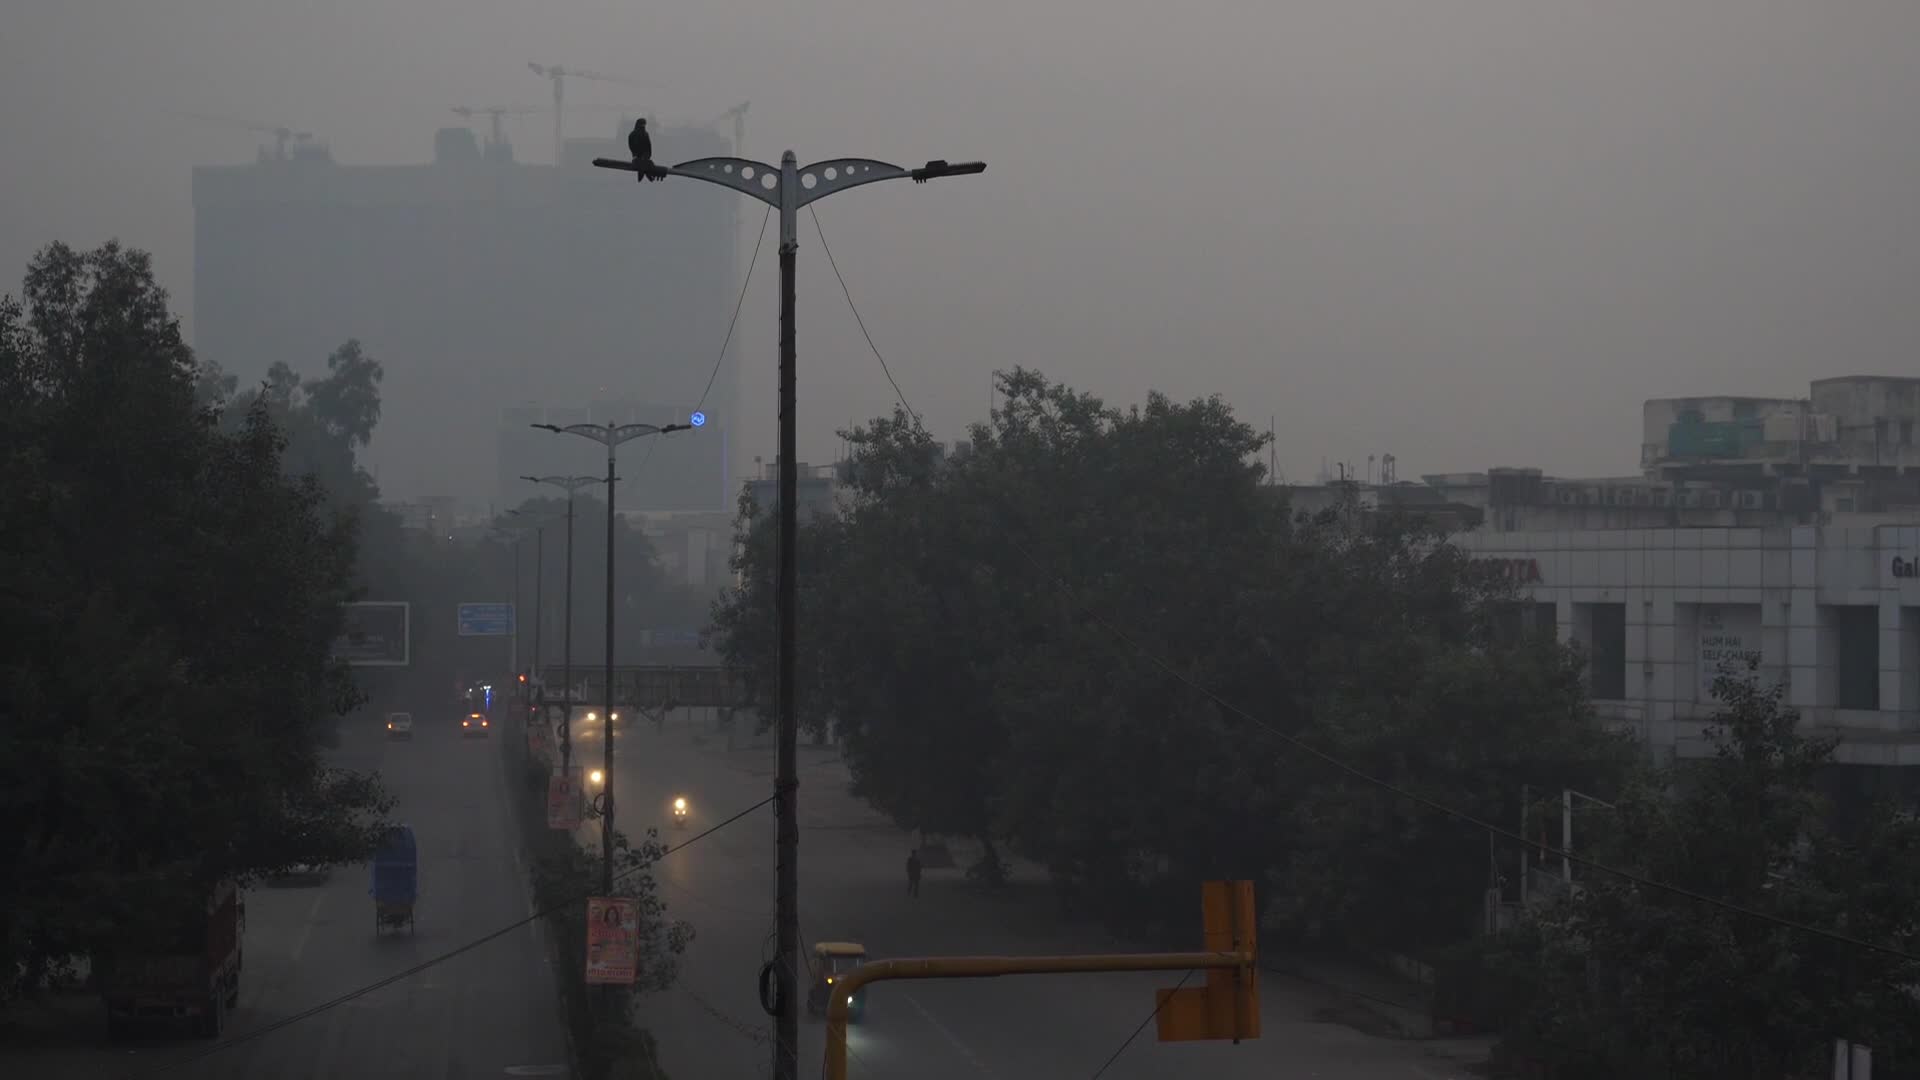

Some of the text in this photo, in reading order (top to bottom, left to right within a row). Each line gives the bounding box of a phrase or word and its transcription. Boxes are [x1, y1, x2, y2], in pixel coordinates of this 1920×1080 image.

[1891, 555, 1920, 579] Gal
[1702, 635, 1743, 649] HUM HAI
